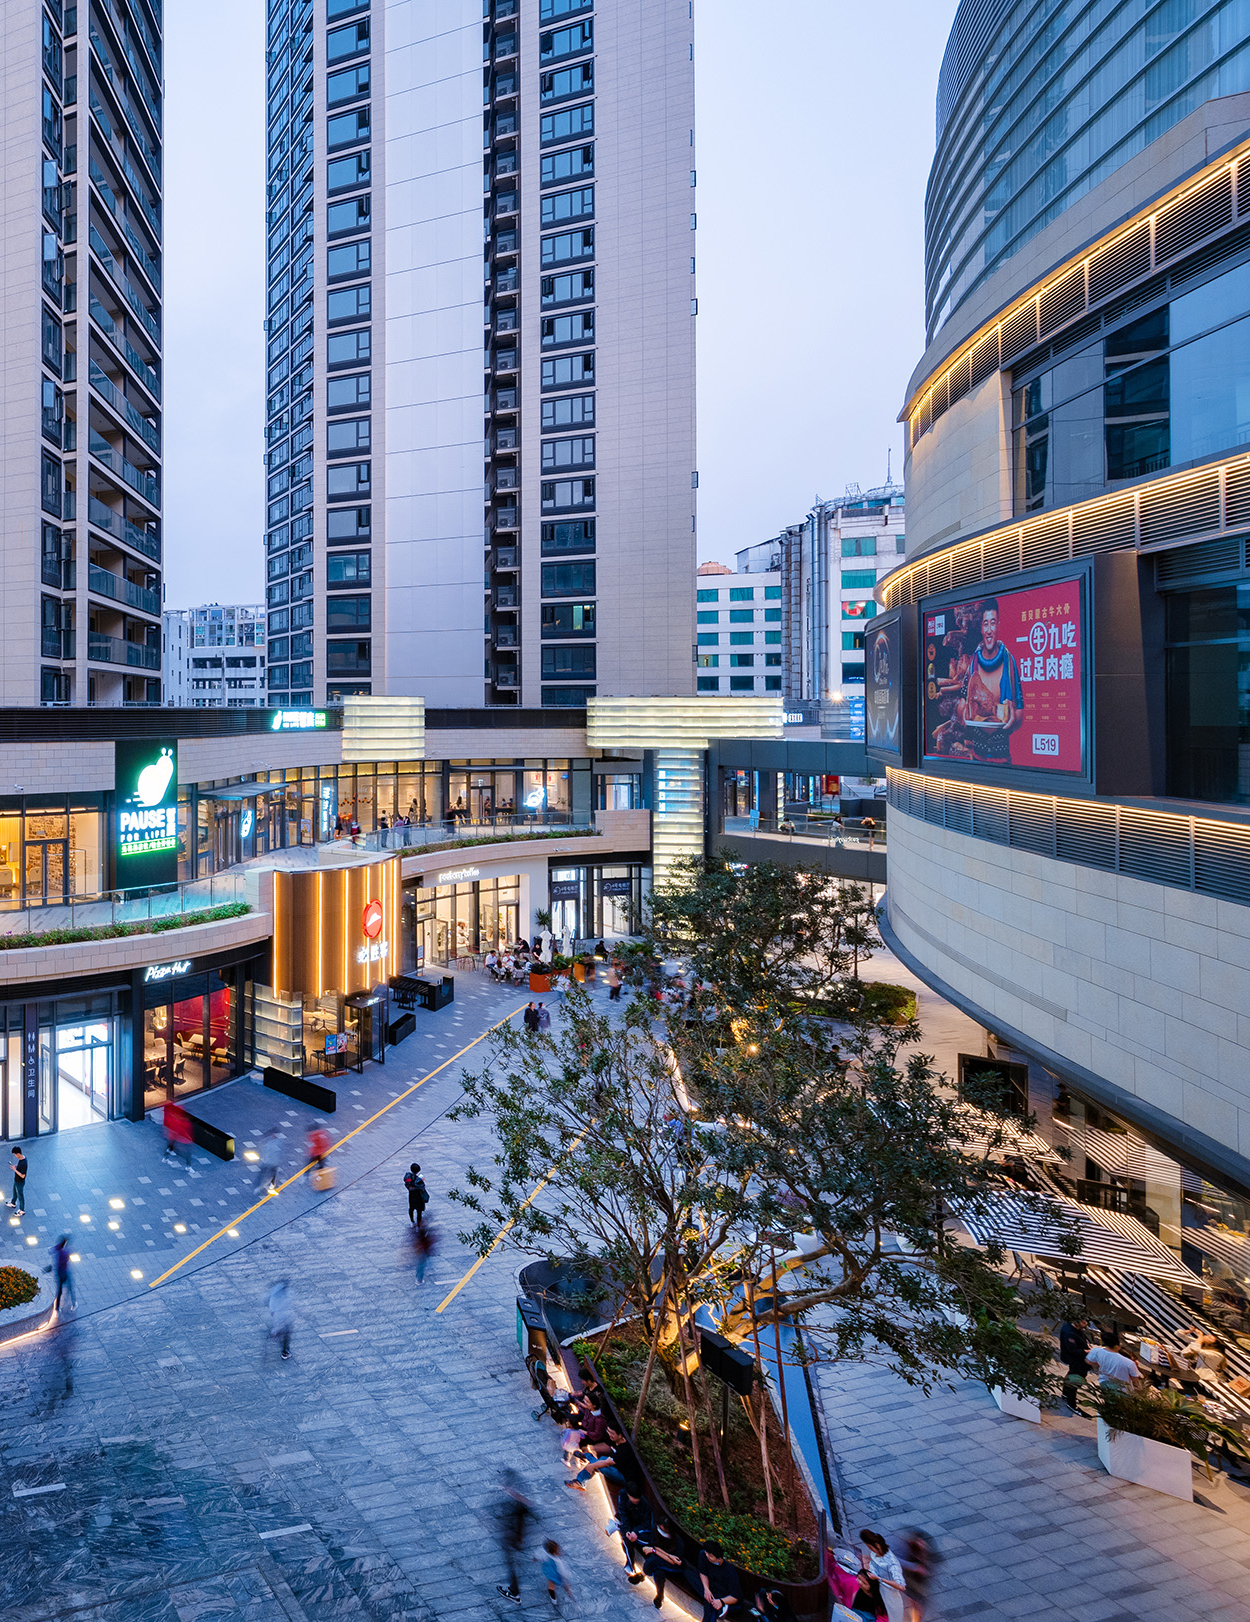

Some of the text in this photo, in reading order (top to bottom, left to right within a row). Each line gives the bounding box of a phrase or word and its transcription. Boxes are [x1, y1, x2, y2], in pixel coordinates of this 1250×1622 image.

[1021, 603, 1070, 622] 西贝蒙古牛大骨
[1016, 621, 1077, 655] 一牛九吃
[1020, 653, 1074, 682] 过足肉瘾
[1034, 737, 1057, 752] L519
[120, 808, 166, 832] PAUSE
[120, 829, 166, 843] FOR LIFE
[144, 960, 192, 983] Pizza Hut
[28, 1068, 36, 1099] 卫生间
